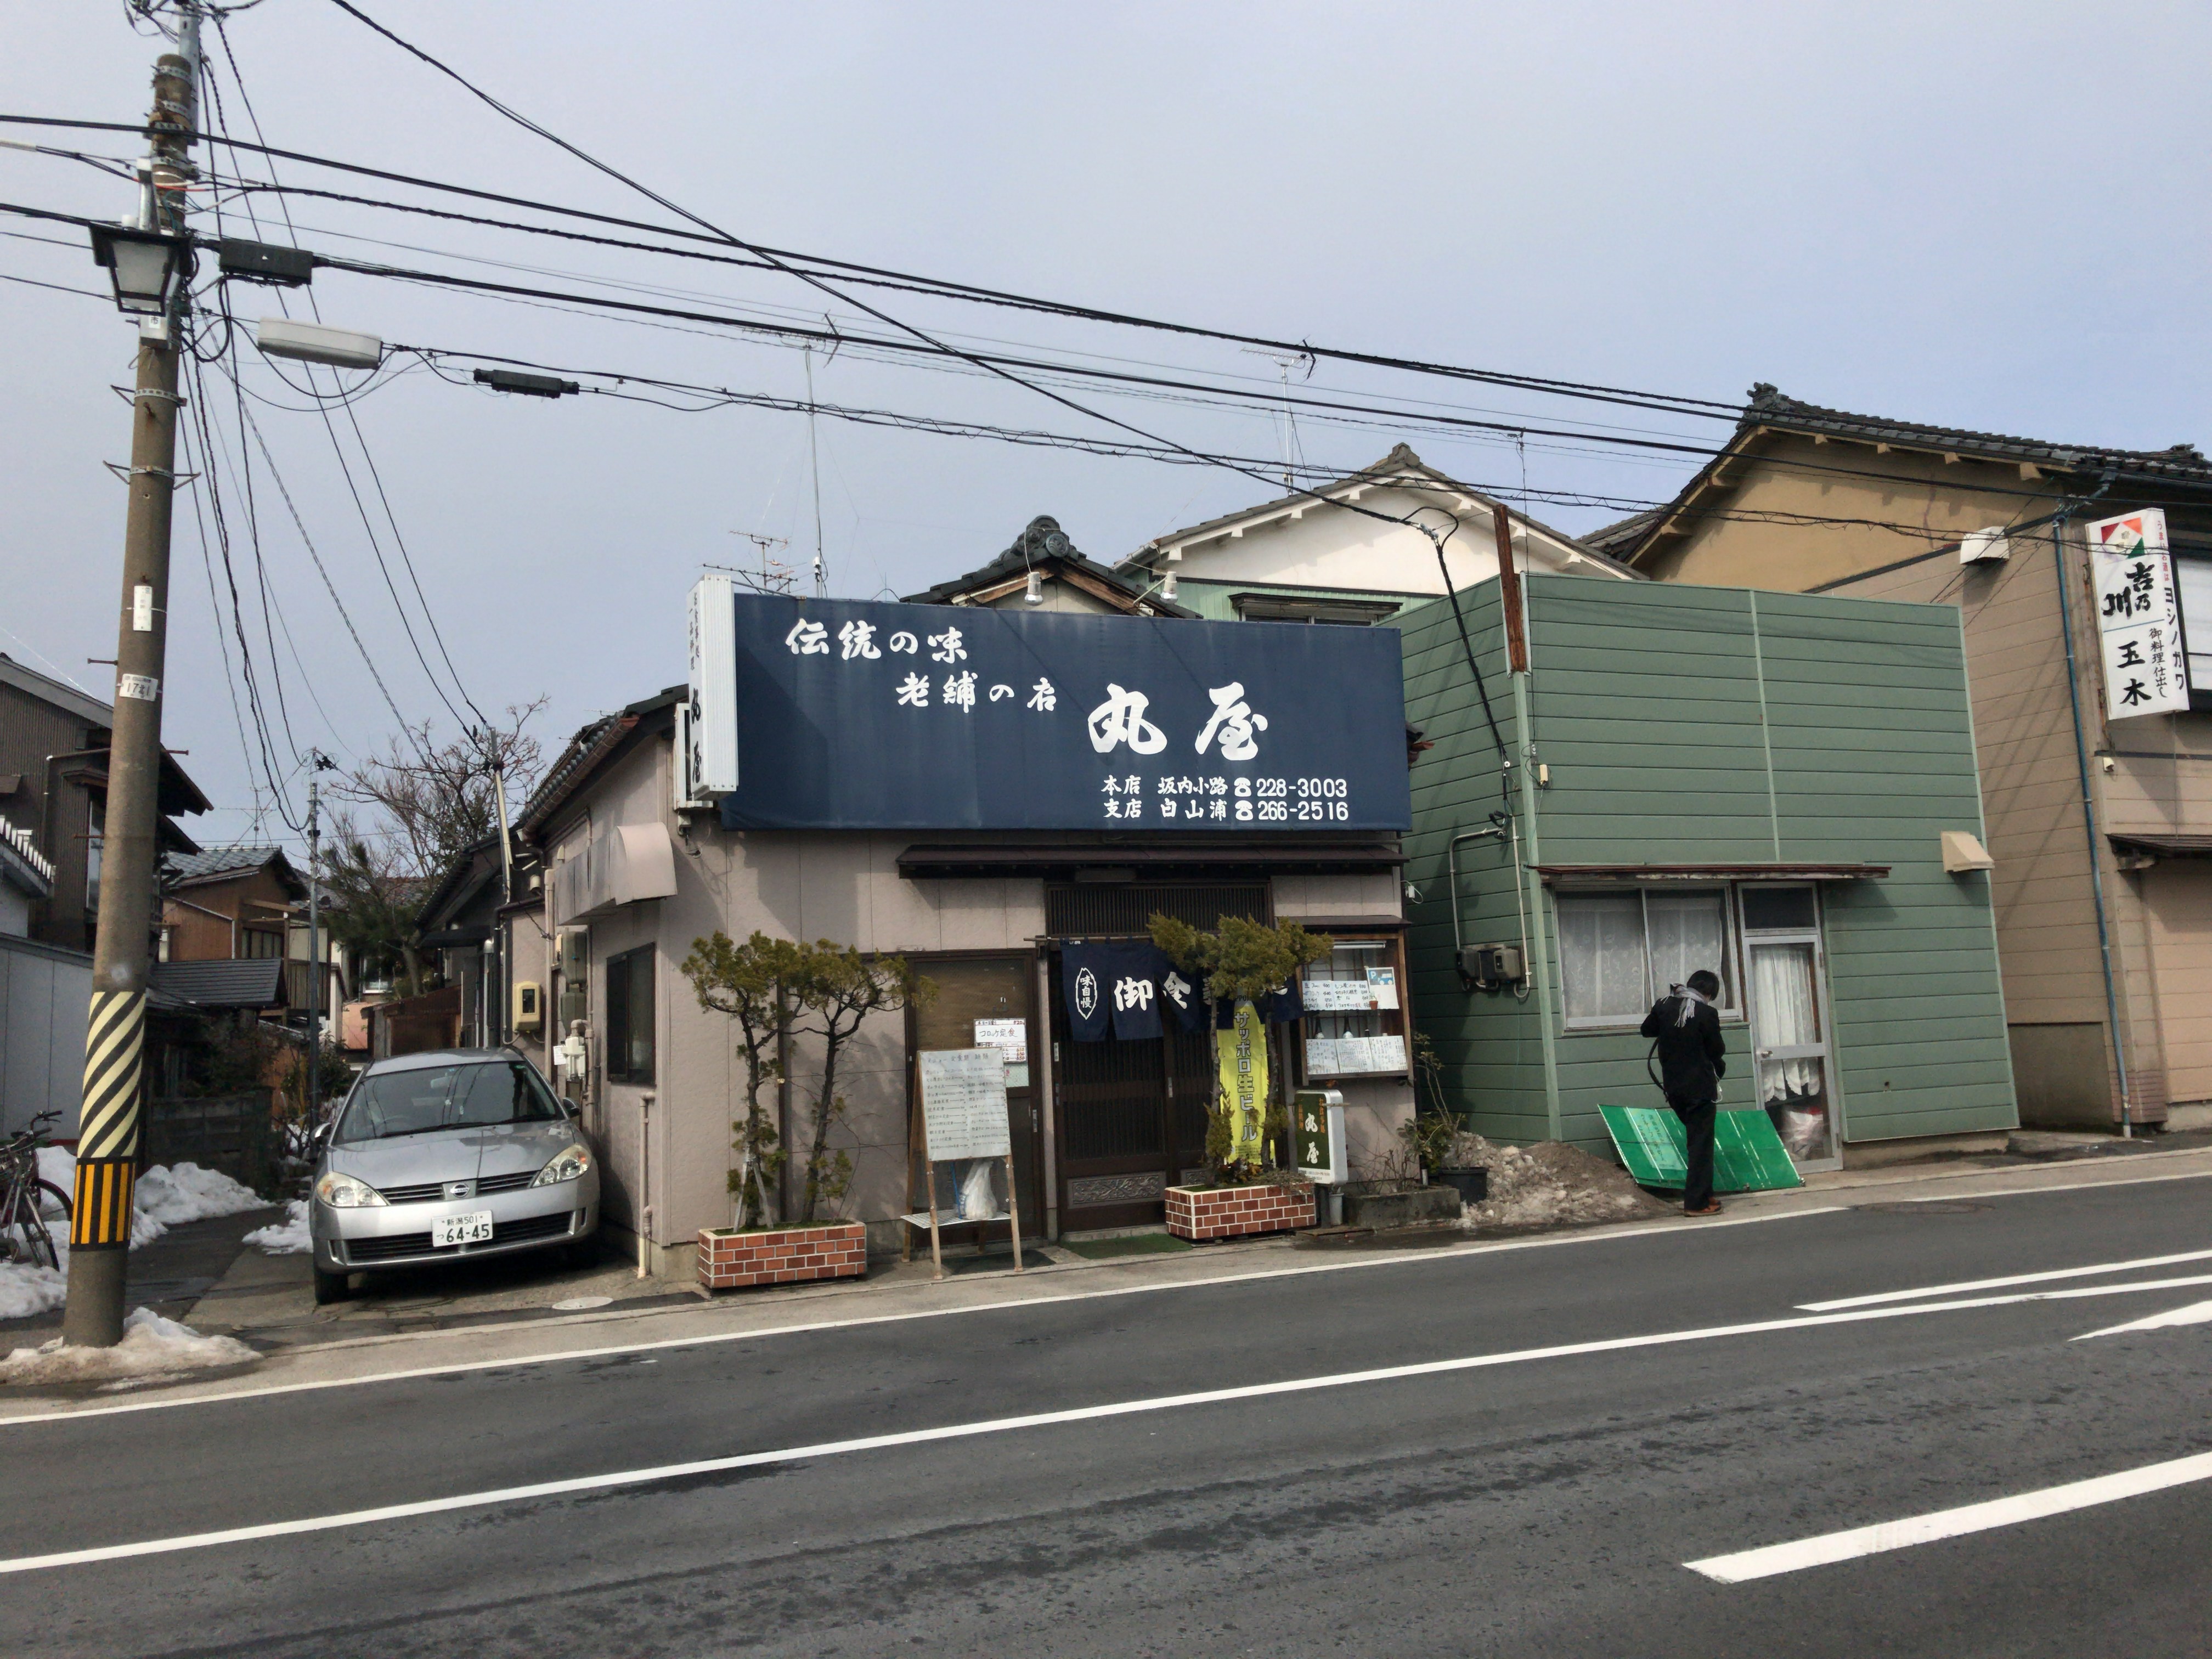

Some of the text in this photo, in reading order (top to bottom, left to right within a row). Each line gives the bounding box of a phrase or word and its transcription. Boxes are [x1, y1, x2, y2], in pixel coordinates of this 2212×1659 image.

[785, 618, 967, 663] 伝統の味
[895, 670, 1057, 713] 老舗の店
[2117, 640, 2152, 707] 玉木
[1088, 682, 1268, 760] 丸屋
[1101, 775, 1347, 798] 本店 坂内小路 228-3003
[1103, 799, 1349, 821] 支店 白山浦 266-2516
[1080, 974, 1093, 1008] 味自慢
[979, 1028, 1018, 1037] コロッケ定食
[1234, 1012, 1257, 1142] サッポロ生ビール
[1305, 1113, 1319, 1164] 丸屋
[446, 1223, 490, 1243] 64-45
